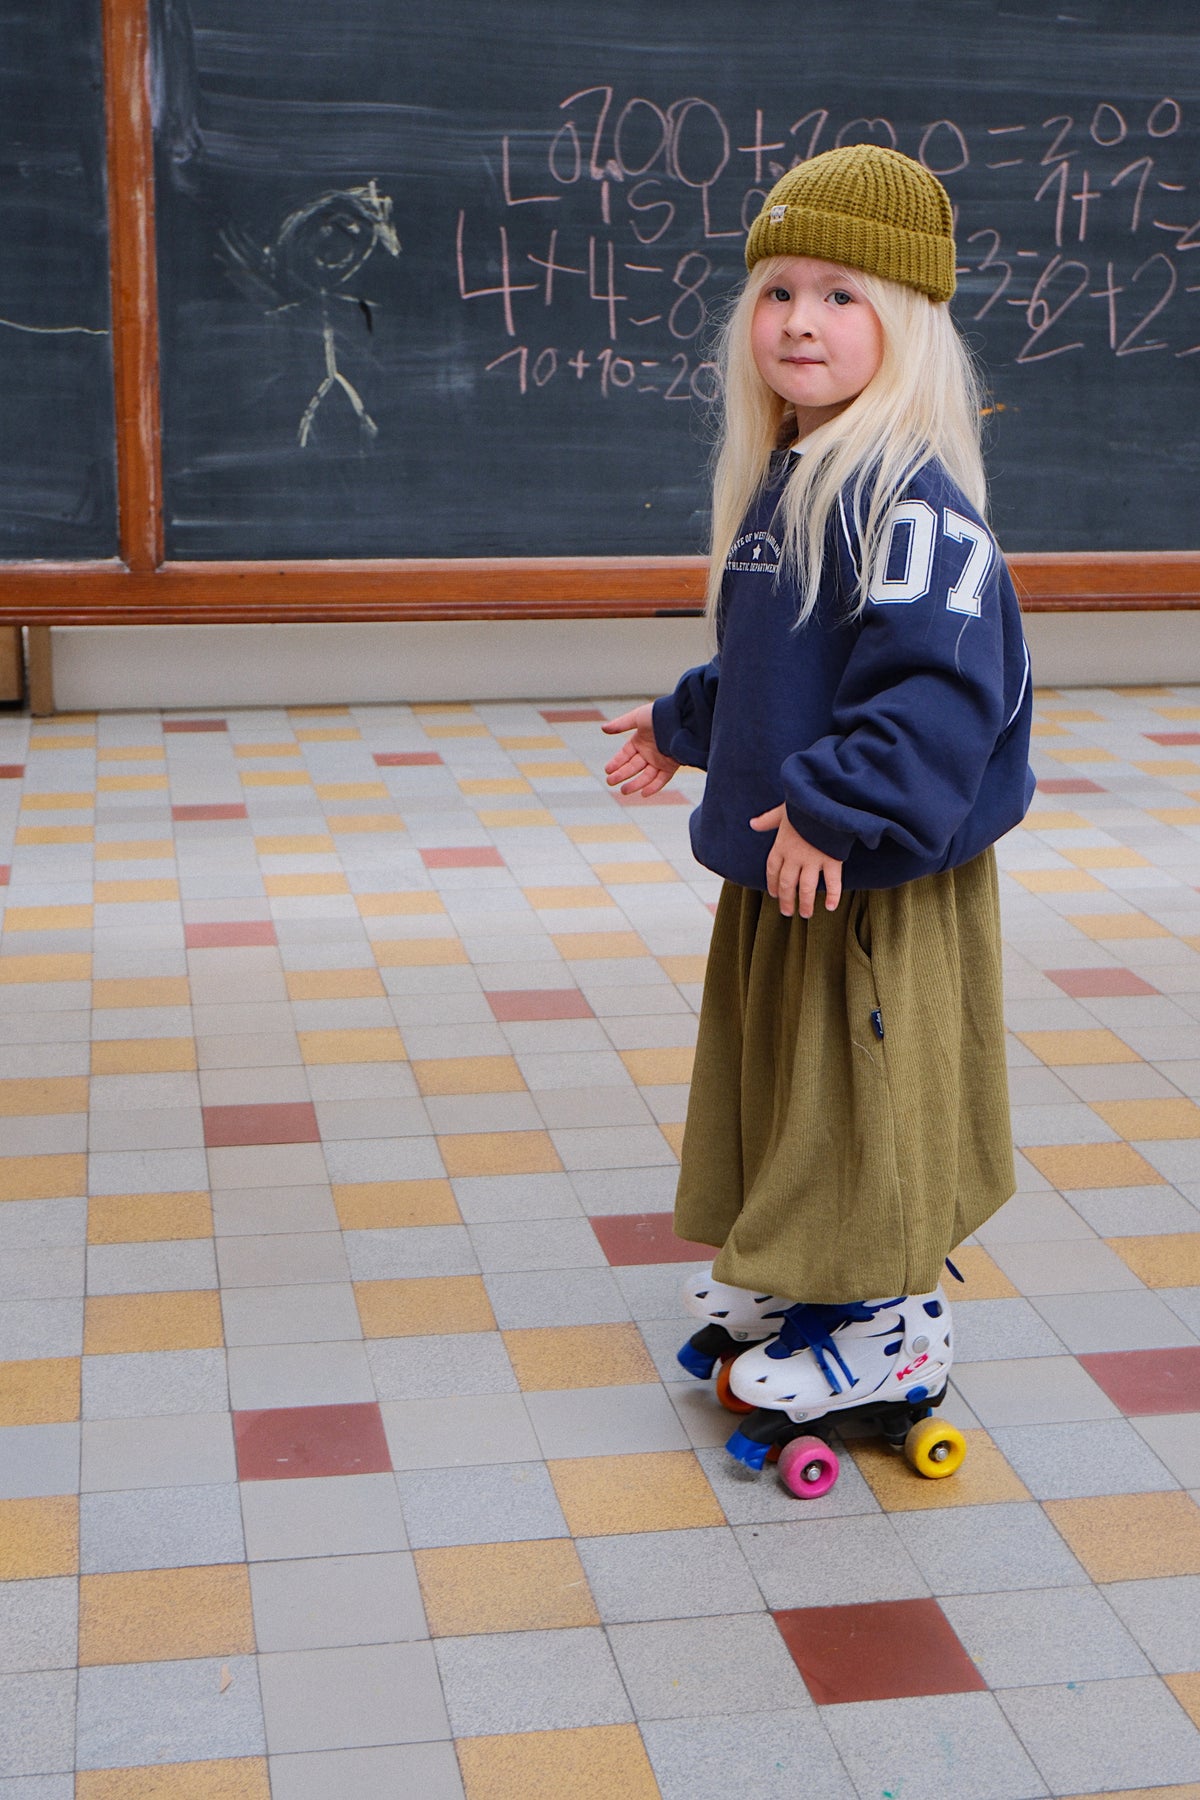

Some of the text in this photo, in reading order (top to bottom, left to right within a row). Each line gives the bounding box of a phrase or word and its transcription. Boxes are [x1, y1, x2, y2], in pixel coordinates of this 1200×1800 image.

[484, 346, 724, 401] 10+10=20
[745, 533, 753, 543] OF
[868, 499, 994, 617] 07
[896, 1353, 928, 1382] K3
